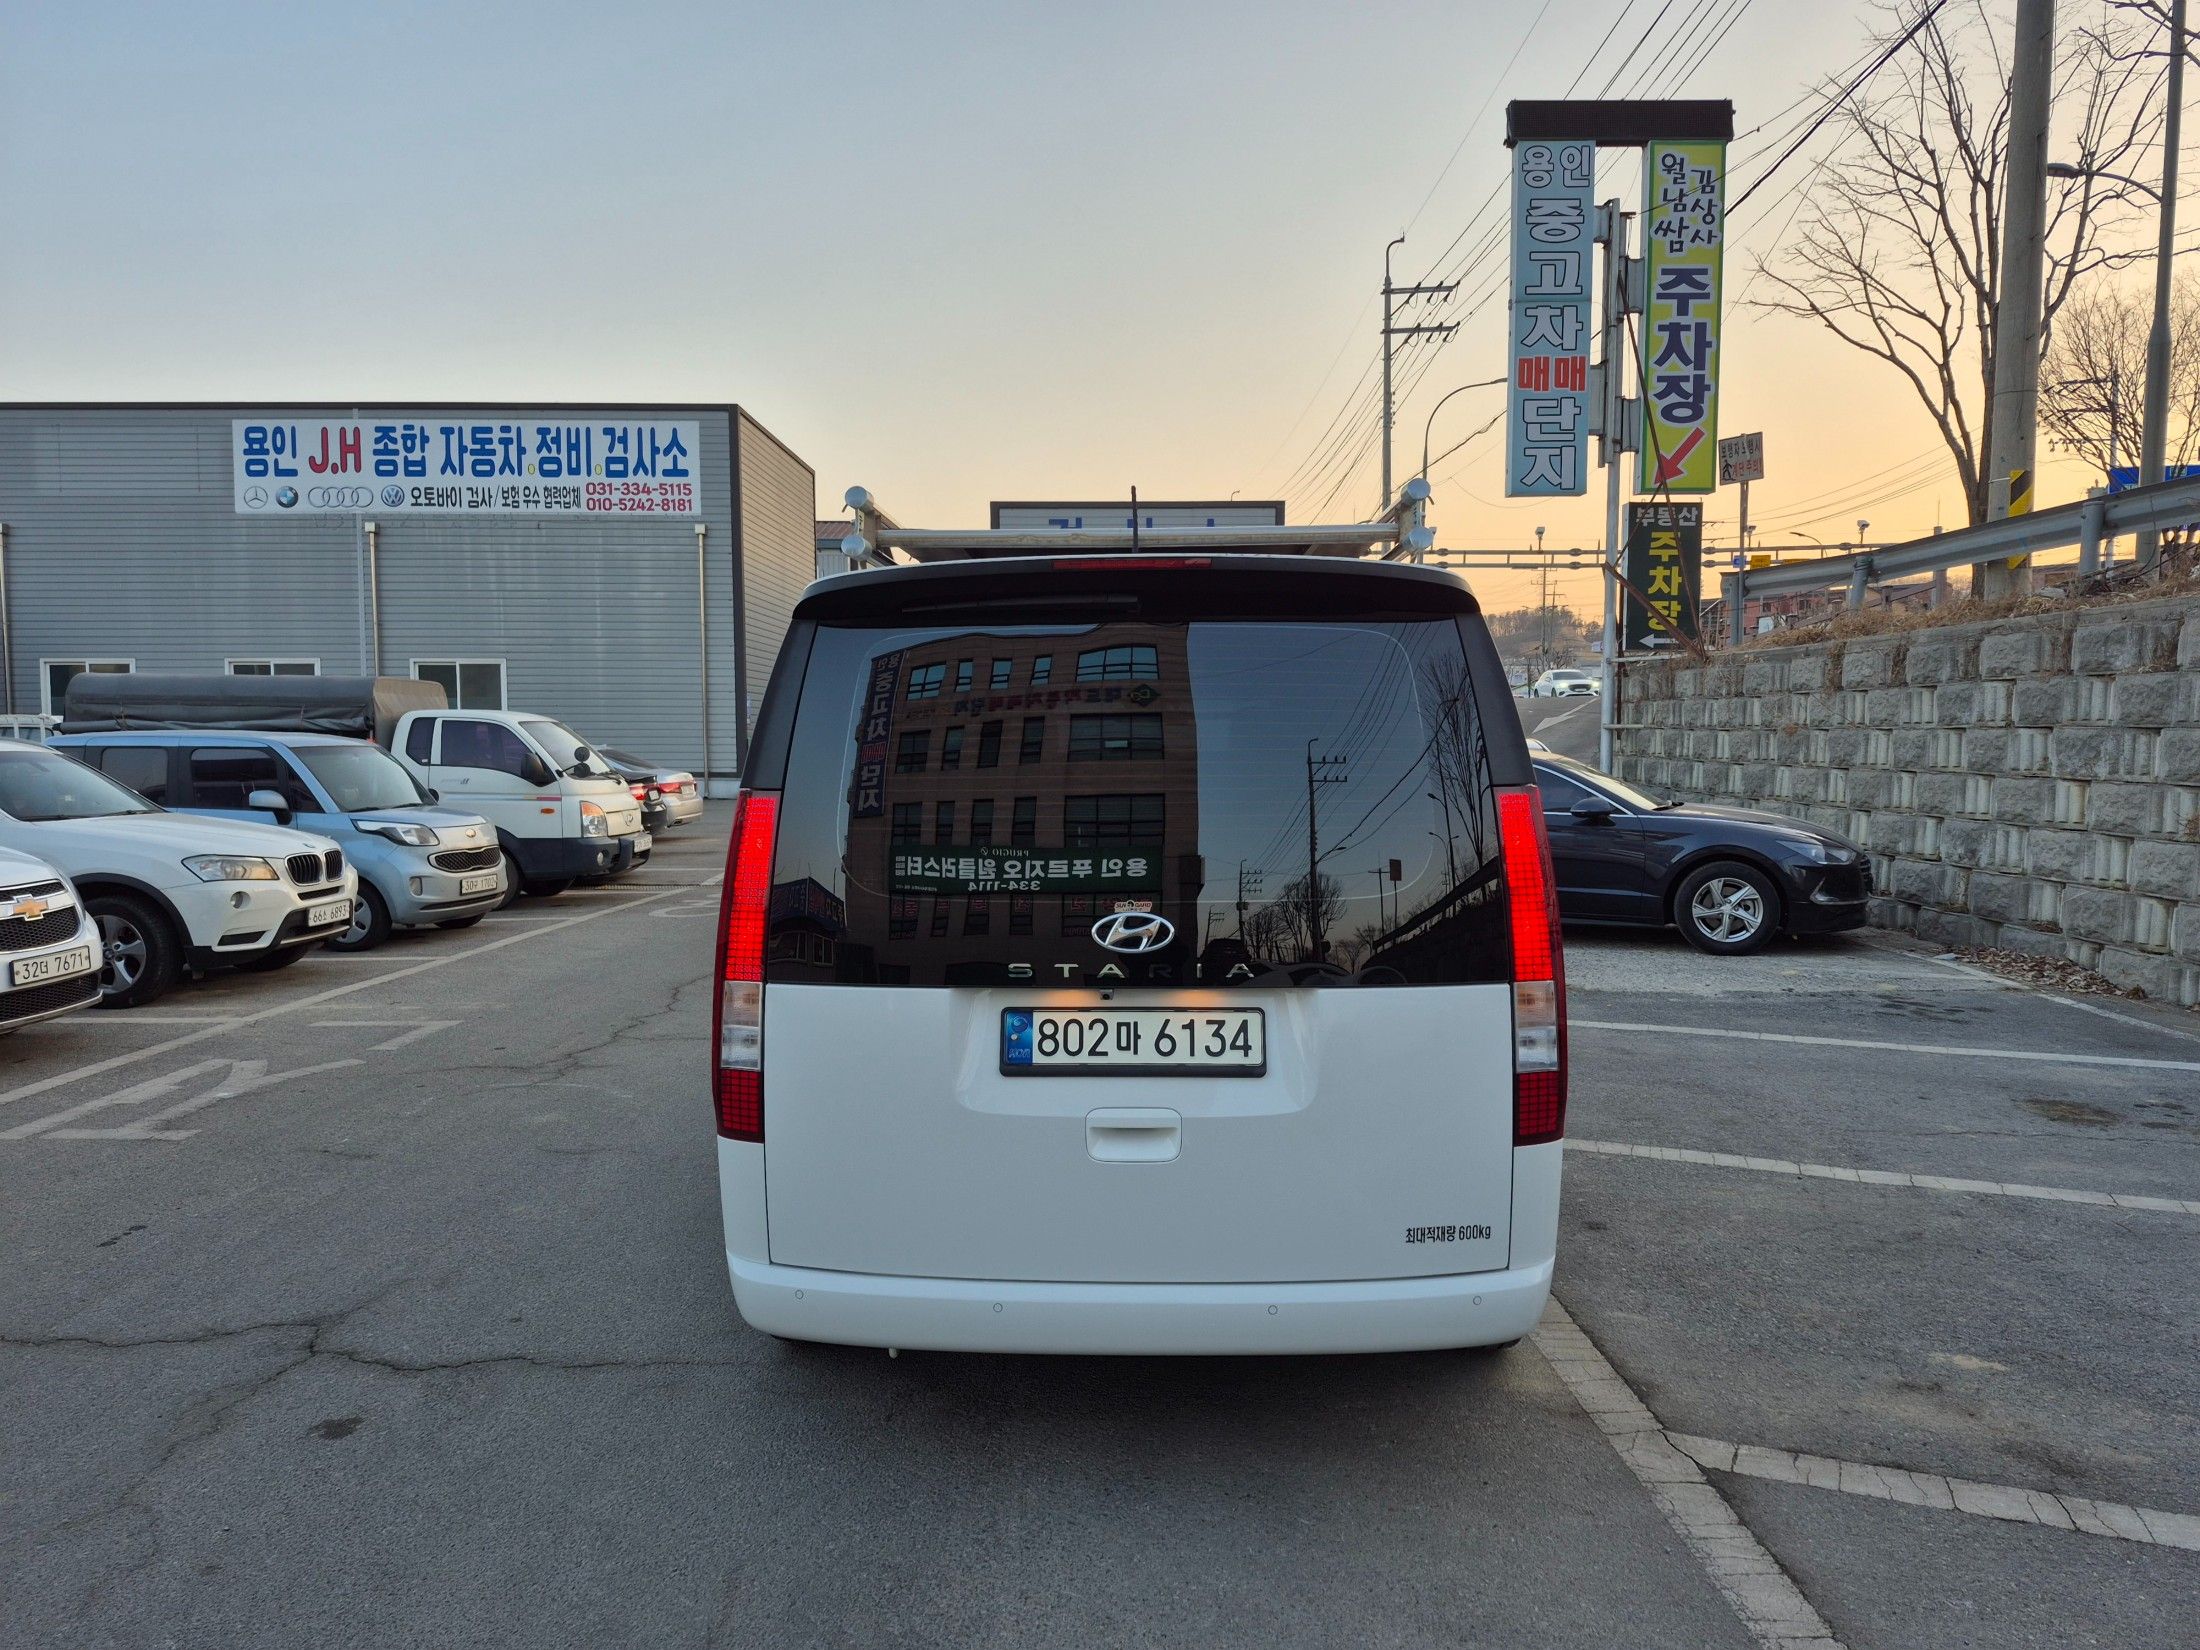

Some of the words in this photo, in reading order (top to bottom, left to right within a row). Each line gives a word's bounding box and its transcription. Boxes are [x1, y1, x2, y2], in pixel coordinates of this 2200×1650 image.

[1522, 145, 1590, 188] 용인
[1654, 152, 1689, 253] 월남쌈
[1690, 167, 1718, 245] 김상사
[1521, 198, 1584, 351] 중고차
[1653, 267, 1712, 424] 주차장
[1517, 356, 1586, 391] 매매
[242, 425, 298, 477] 용인
[308, 426, 361, 475] J.H
[372, 424, 429, 478] 종합
[1521, 397, 1580, 490] 단지
[410, 486, 462, 508] 오토바이
[523, 486, 541, 509] 우수
[543, 486, 581, 509] 협력업체
[585, 482, 692, 496] 031-334-5115
[586, 497, 692, 512] 010-5242-8181
[1635, 507, 1698, 527] 부동산
[1647, 531, 1682, 631] 주차장
[22, 960, 48, 979] 32더
[54, 952, 83, 972] 7671
[1007, 963, 1254, 979] STARIA
[1037, 1018, 1141, 1057] 802마
[1154, 1018, 1252, 1057] 6134
[1405, 1225, 1456, 1244] 최대적재량
[1458, 1224, 1491, 1240] 600kg
